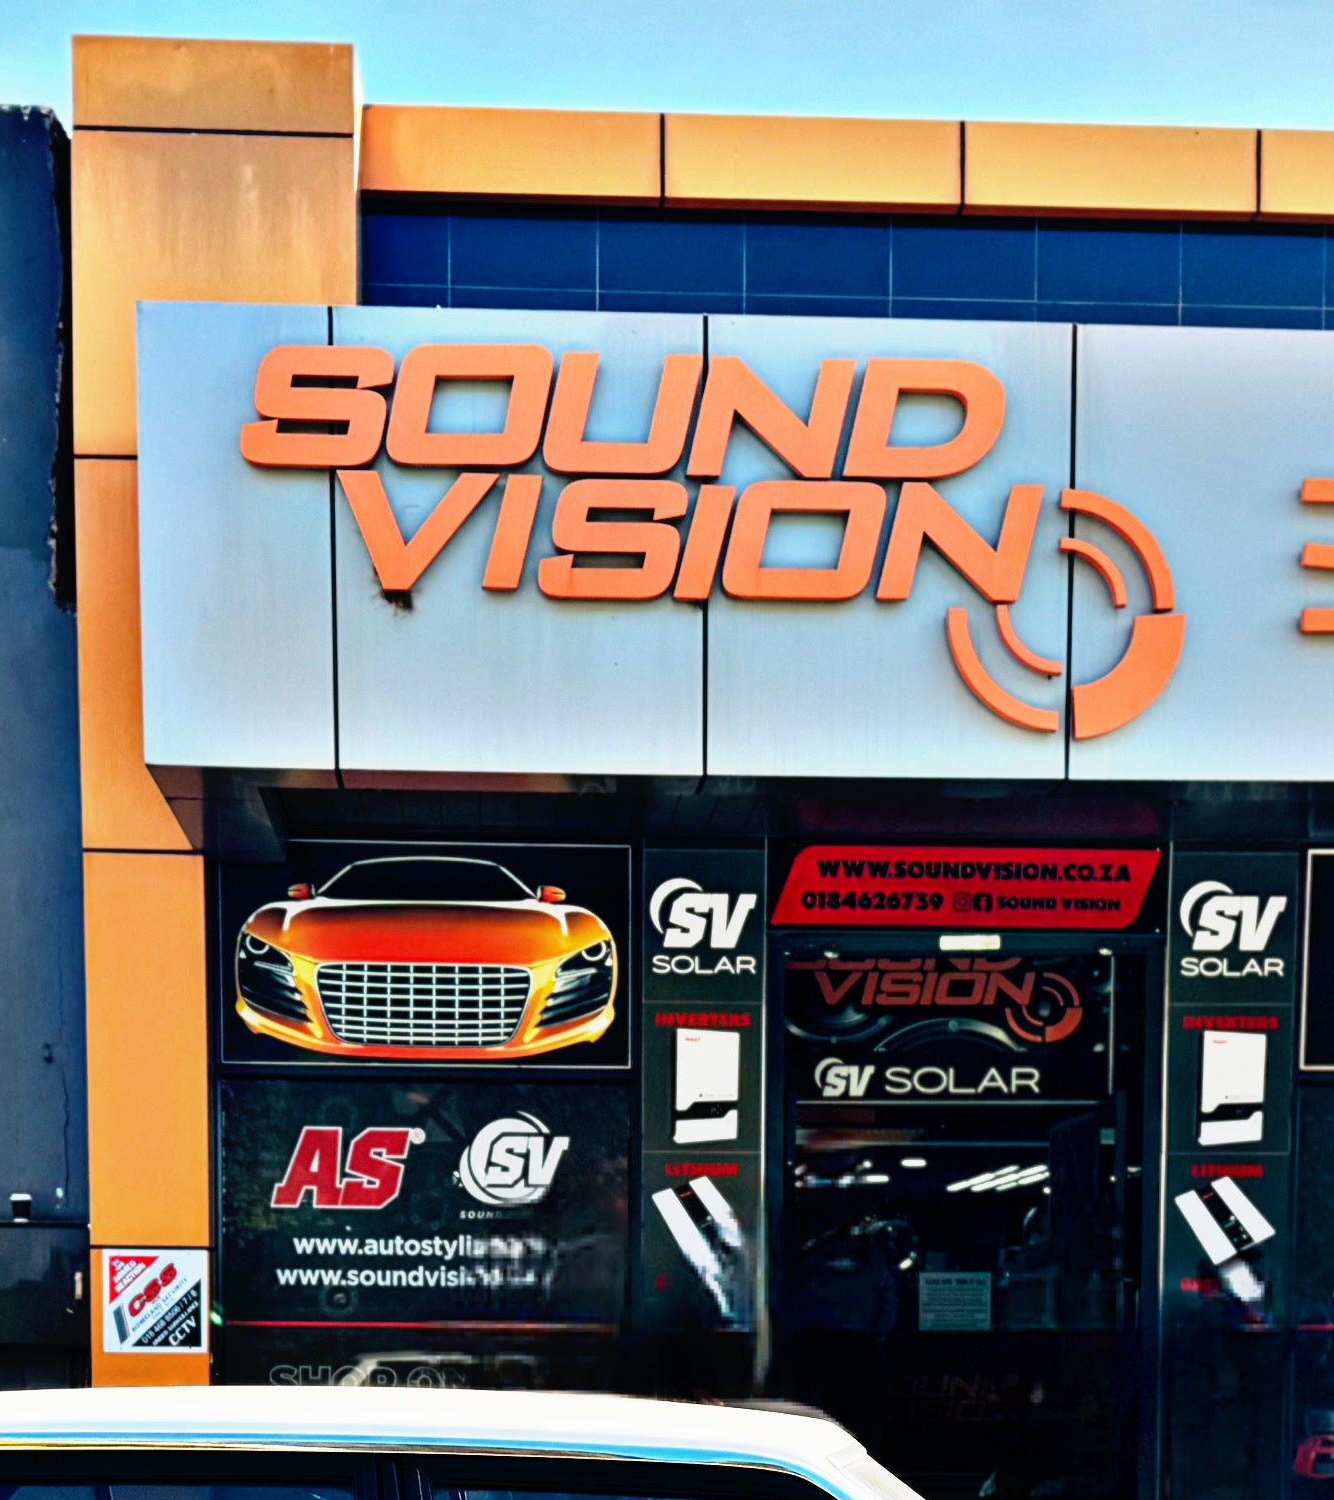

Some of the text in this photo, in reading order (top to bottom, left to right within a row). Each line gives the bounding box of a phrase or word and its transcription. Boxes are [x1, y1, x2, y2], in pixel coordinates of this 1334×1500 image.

[239, 342, 1005, 480] SOUND
[336, 468, 1046, 604] VISION
[817, 859, 1132, 883] WWW.SOUNDVISION.CO.ZA
[801, 891, 944, 911] 0184626739
[996, 896, 1121, 912] SOUND VISION
[662, 892, 758, 949] SV
[1191, 895, 1289, 952] SV
[651, 954, 757, 975] SOLAR
[1180, 956, 1285, 977] SOLAR
[813, 970, 1037, 1006] VISION
[884, 1066, 1041, 1094] SOLAR
[270, 1125, 413, 1210] AS
[293, 1234, 547, 1262] www.autostyli
[275, 1264, 537, 1289] www.soundvisi
[168, 1316, 198, 1346] CCTV
